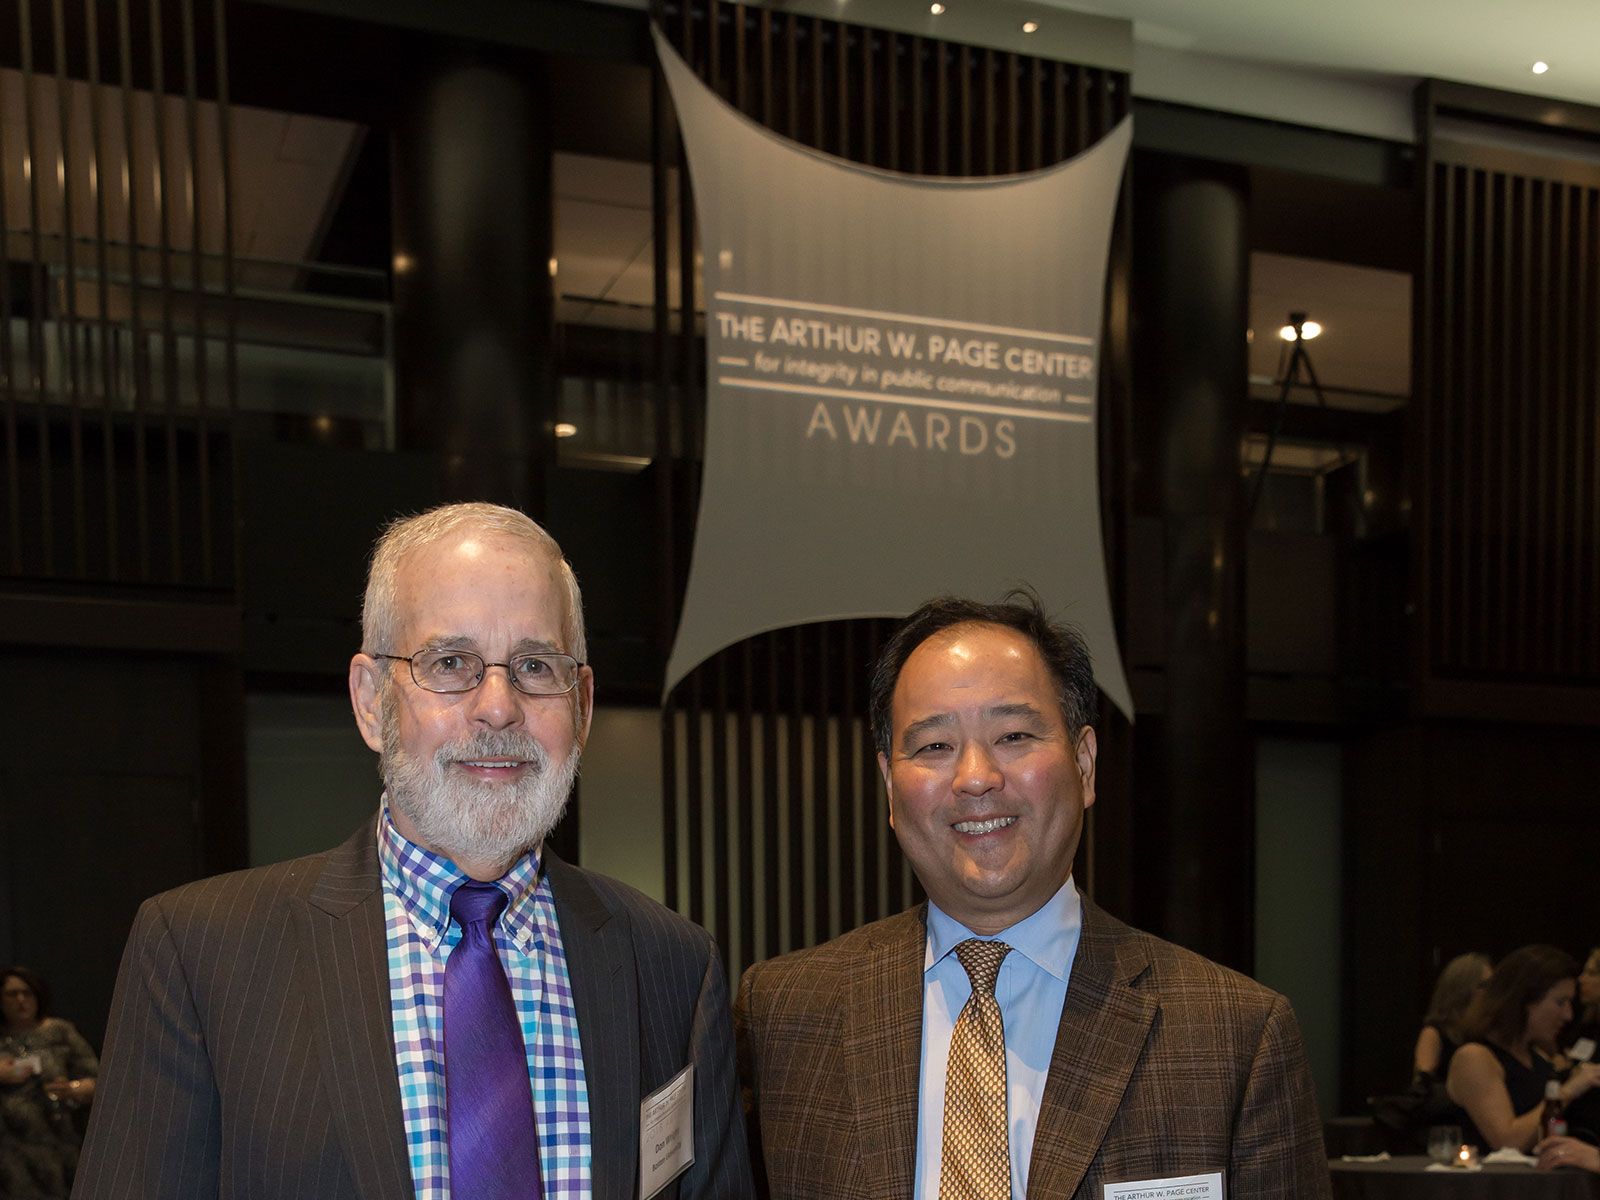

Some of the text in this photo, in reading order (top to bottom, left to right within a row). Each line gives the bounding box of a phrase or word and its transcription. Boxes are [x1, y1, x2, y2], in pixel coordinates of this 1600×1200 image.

[716, 312, 1093, 380] THE ARTHUR W. PAGE CENTER
[754, 352, 1061, 403] for integrity in public communication
[806, 402, 1017, 459] AWARDS
[1127, 1192, 1155, 1200] ARTHUR
[1186, 1186, 1210, 1194] CENTER
